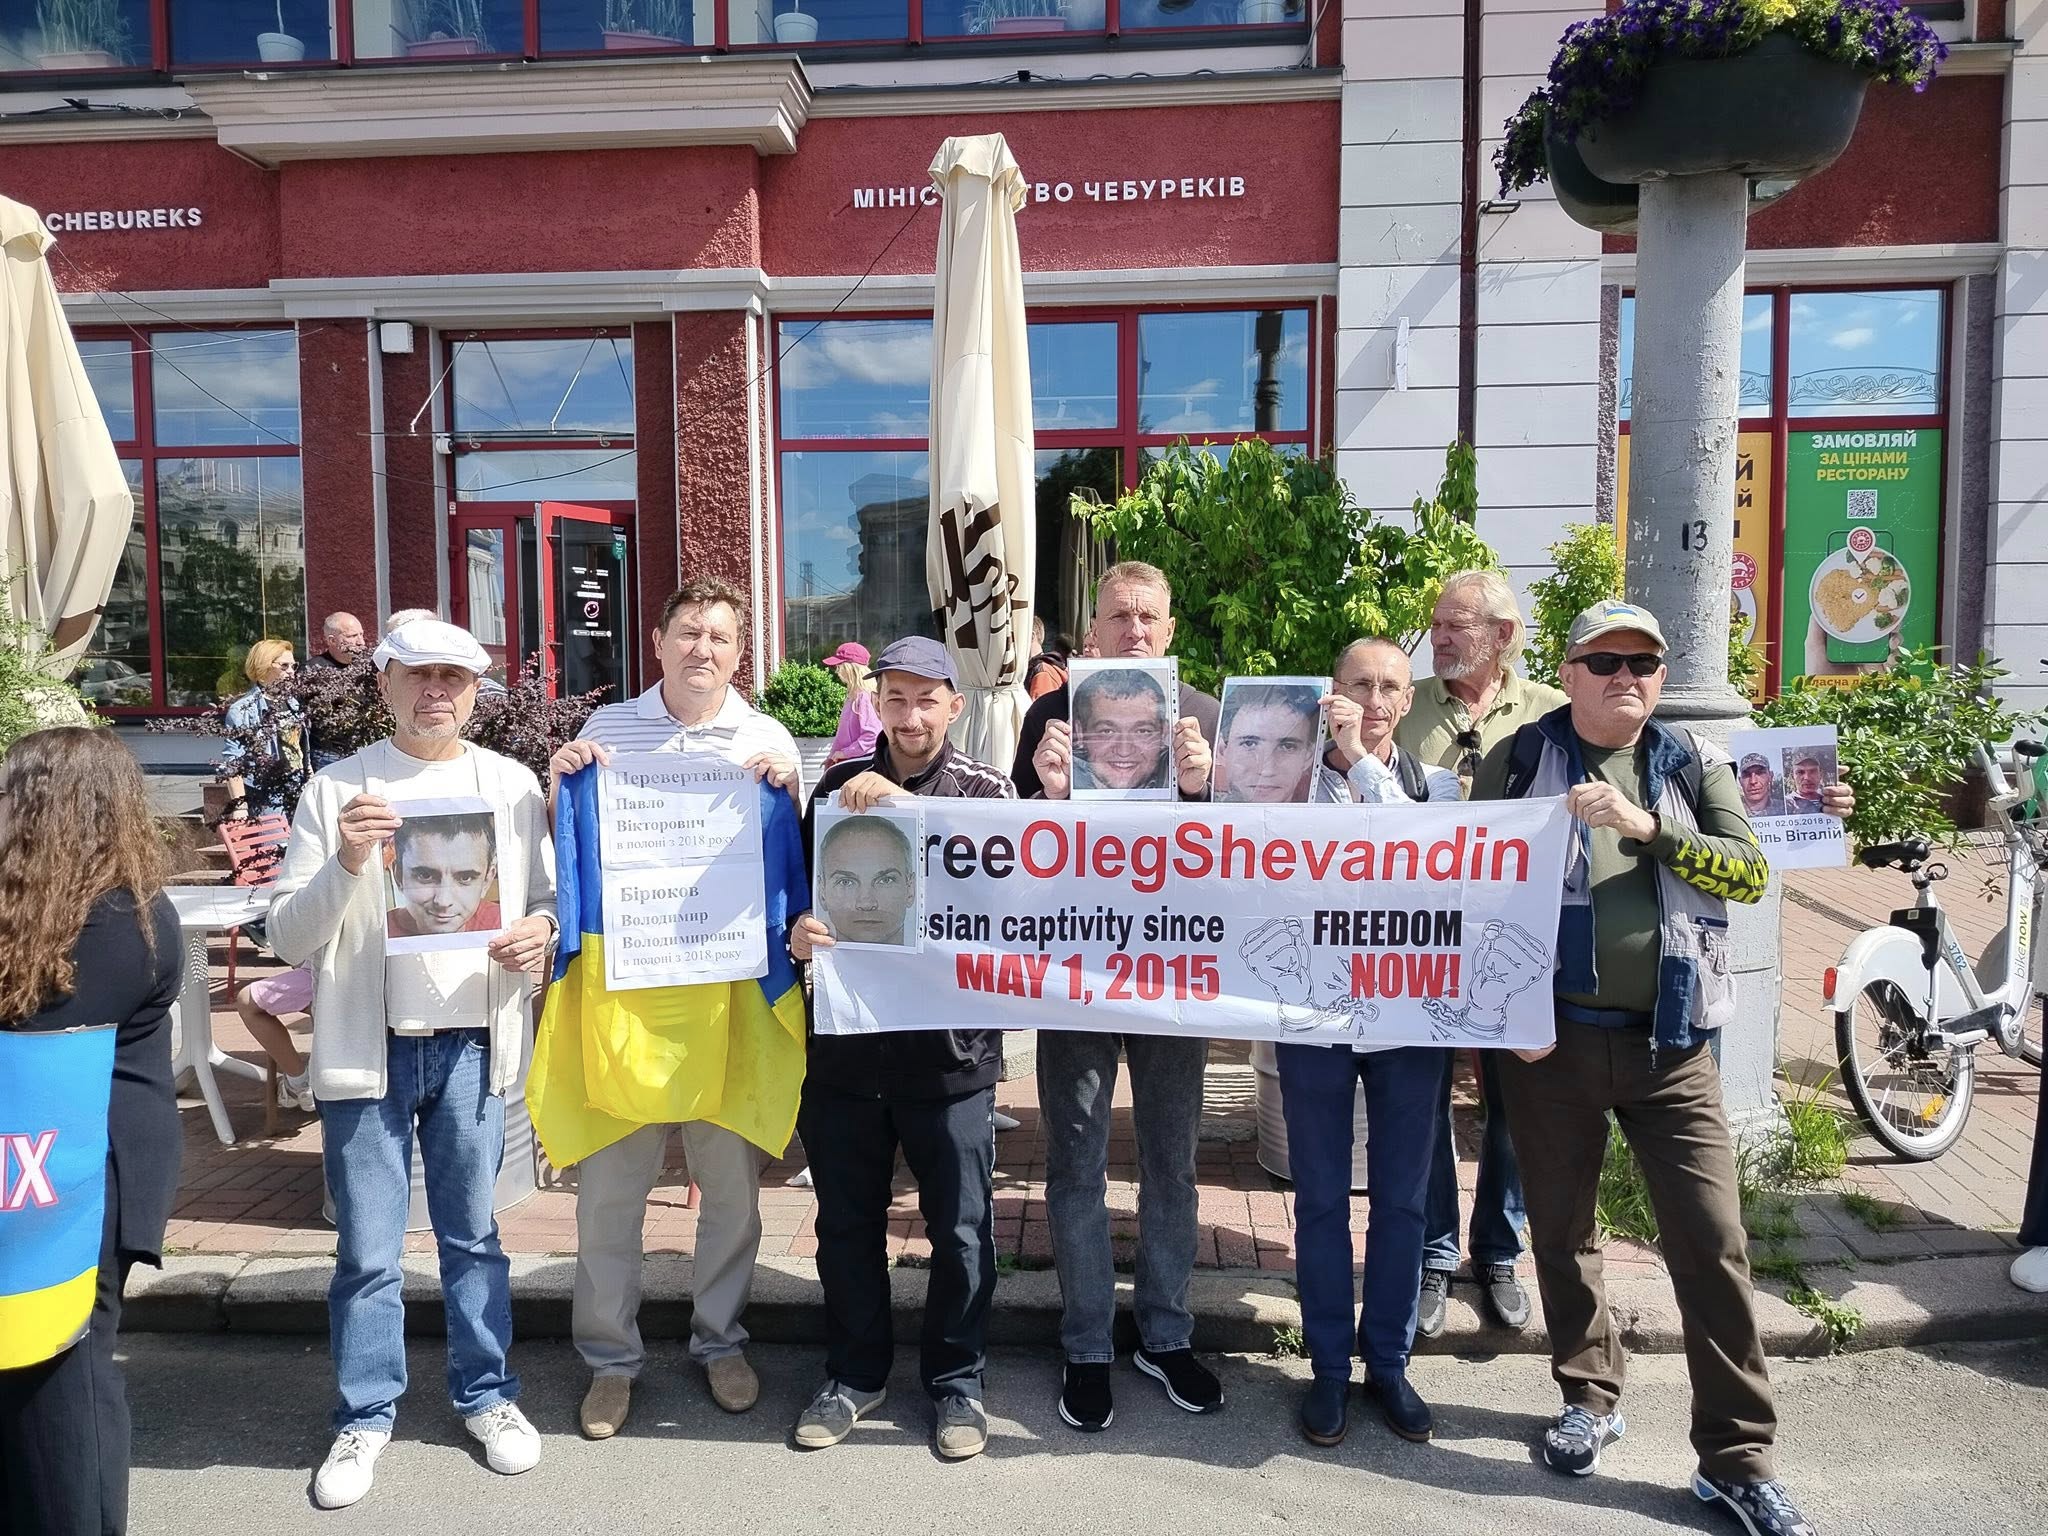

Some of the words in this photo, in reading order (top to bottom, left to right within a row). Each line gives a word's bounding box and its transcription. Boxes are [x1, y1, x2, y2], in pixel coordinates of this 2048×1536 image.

[1084, 176, 1245, 202] ЧЕБУРЕКІВ
[45, 207, 202, 232] CHEBUREKS
[1812, 429, 1917, 449] ЗАМОВЛЯЙ
[1819, 453, 1840, 465] ЗА
[1842, 451, 1908, 466] ЦІНАМИ
[1816, 468, 1910, 482] РЕСТОРАНУ
[1681, 519, 1708, 552] 13
[615, 769, 745, 788] Перевертайло
[616, 797, 664, 810] Павло
[616, 819, 705, 833] Вікторович
[1775, 816, 1824, 828] 02.05.2018
[1826, 817, 1835, 826] р.
[617, 841, 624, 850] в
[627, 836, 666, 849] полоні
[669, 840, 676, 848] з
[679, 835, 705, 847] 2018
[708, 836, 736, 848] року
[1785, 826, 1843, 842] Віталій
[924, 819, 1530, 894] reeOlegShevandin
[620, 886, 700, 905] Бірюков
[621, 911, 709, 927] Володимир
[1000, 905, 1134, 952] captivity
[1142, 905, 1225, 944] since
[1312, 909, 1463, 947] FREEDOM
[622, 930, 746, 949] Володимирович
[2014, 909, 2028, 979] bikenow
[675, 955, 682, 963] з
[685, 949, 712, 962] 2018
[714, 949, 742, 962] року
[1948, 941, 1968, 971] 3762
[955, 953, 1052, 1000] MAY
[1061, 953, 1094, 1006] 1,
[1104, 953, 1220, 1001] 2015
[1351, 952, 1462, 999] NOW!
